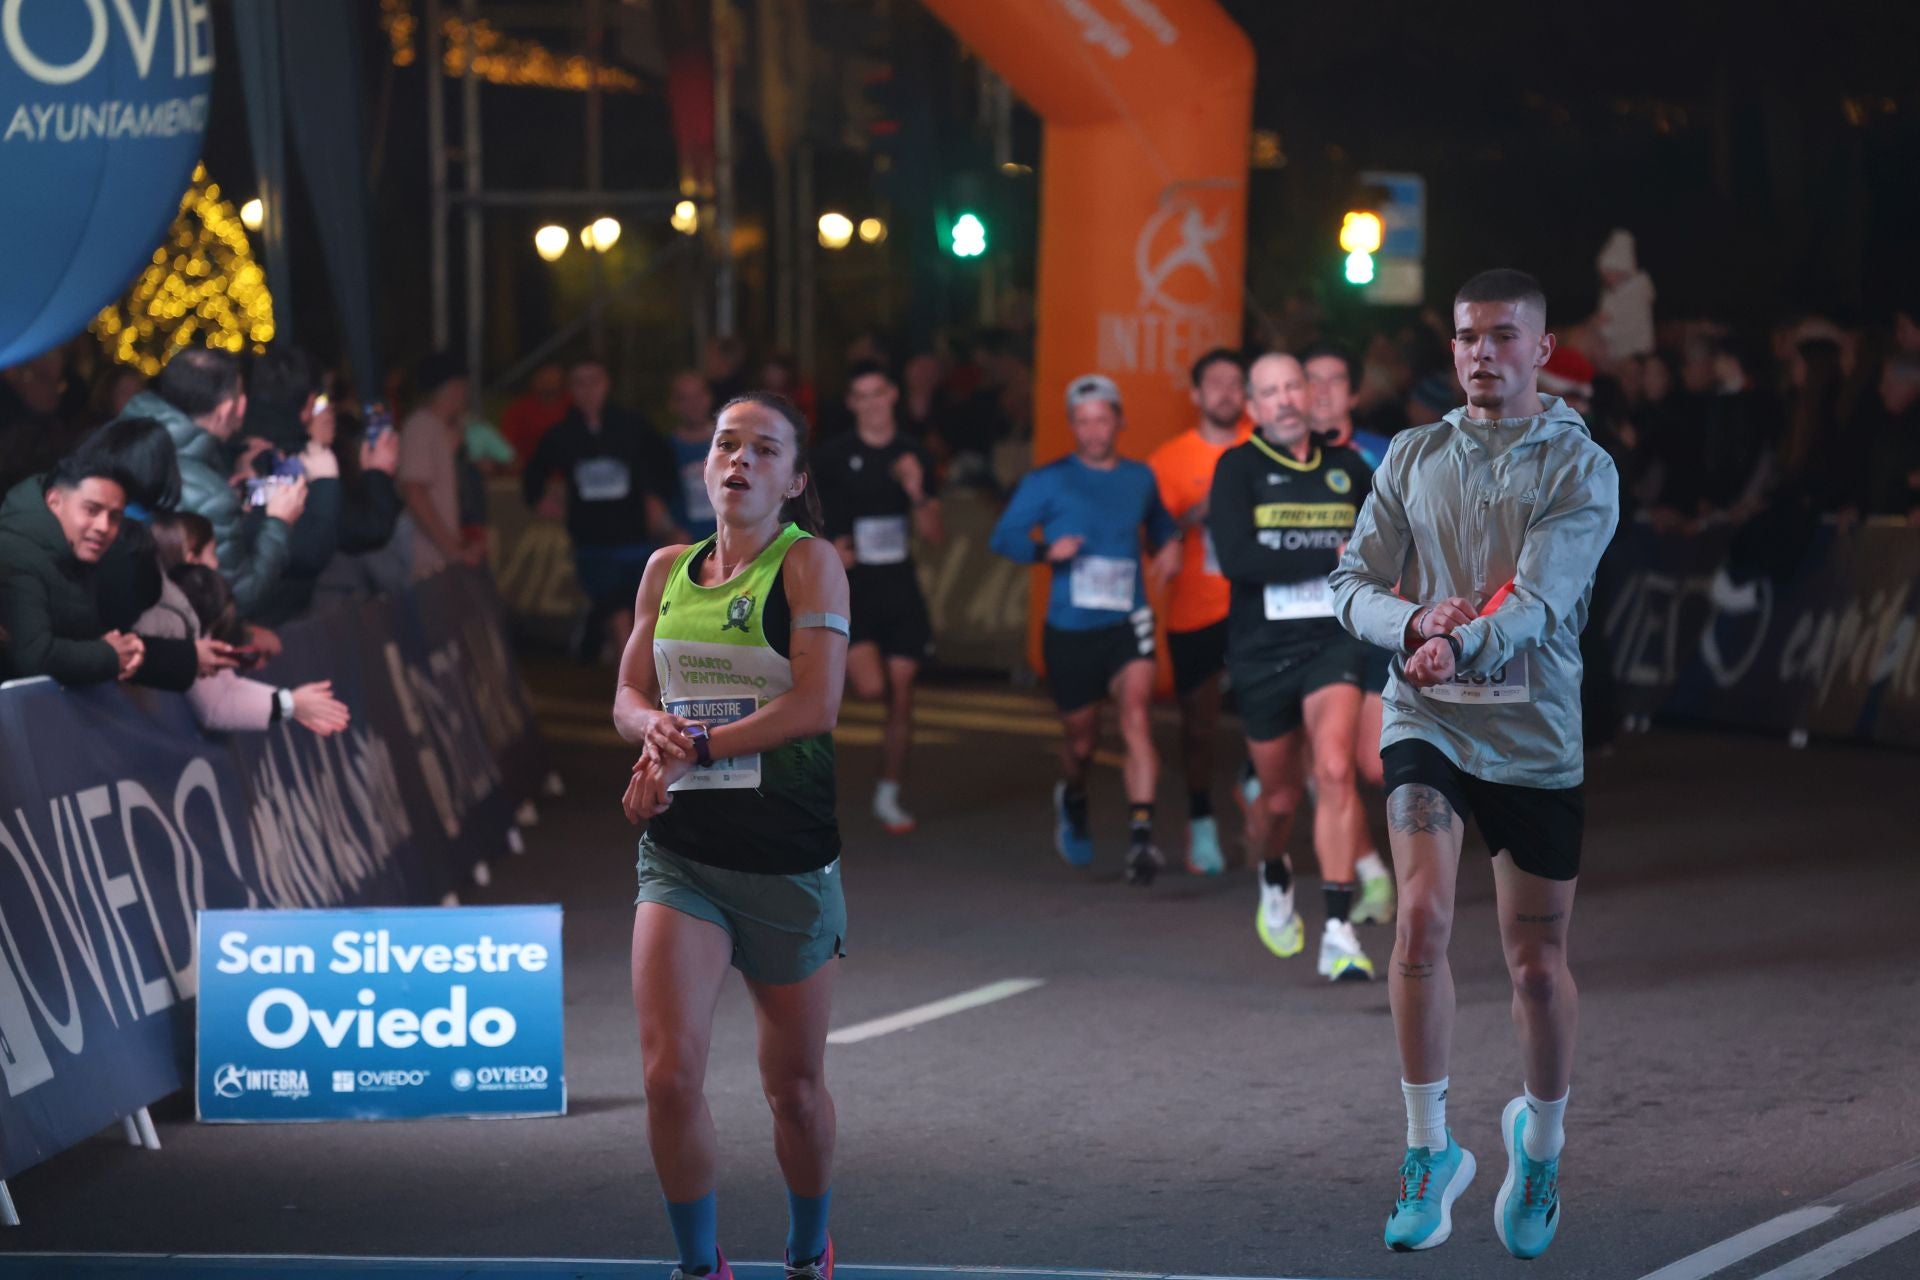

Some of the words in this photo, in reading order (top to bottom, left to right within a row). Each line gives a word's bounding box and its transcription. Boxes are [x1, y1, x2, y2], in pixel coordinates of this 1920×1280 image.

[678, 654, 733, 671] CUARTO
[680, 671, 768, 689] VENTRICULO
[692, 702, 742, 717] SILVESTRE
[216, 931, 315, 974] San
[329, 929, 548, 974] Silvestre
[247, 985, 517, 1049] Oviedo
[246, 1069, 309, 1091] INTEGRA
[357, 1069, 424, 1086] OVIEDO
[476, 1065, 548, 1084] OVIEDO
